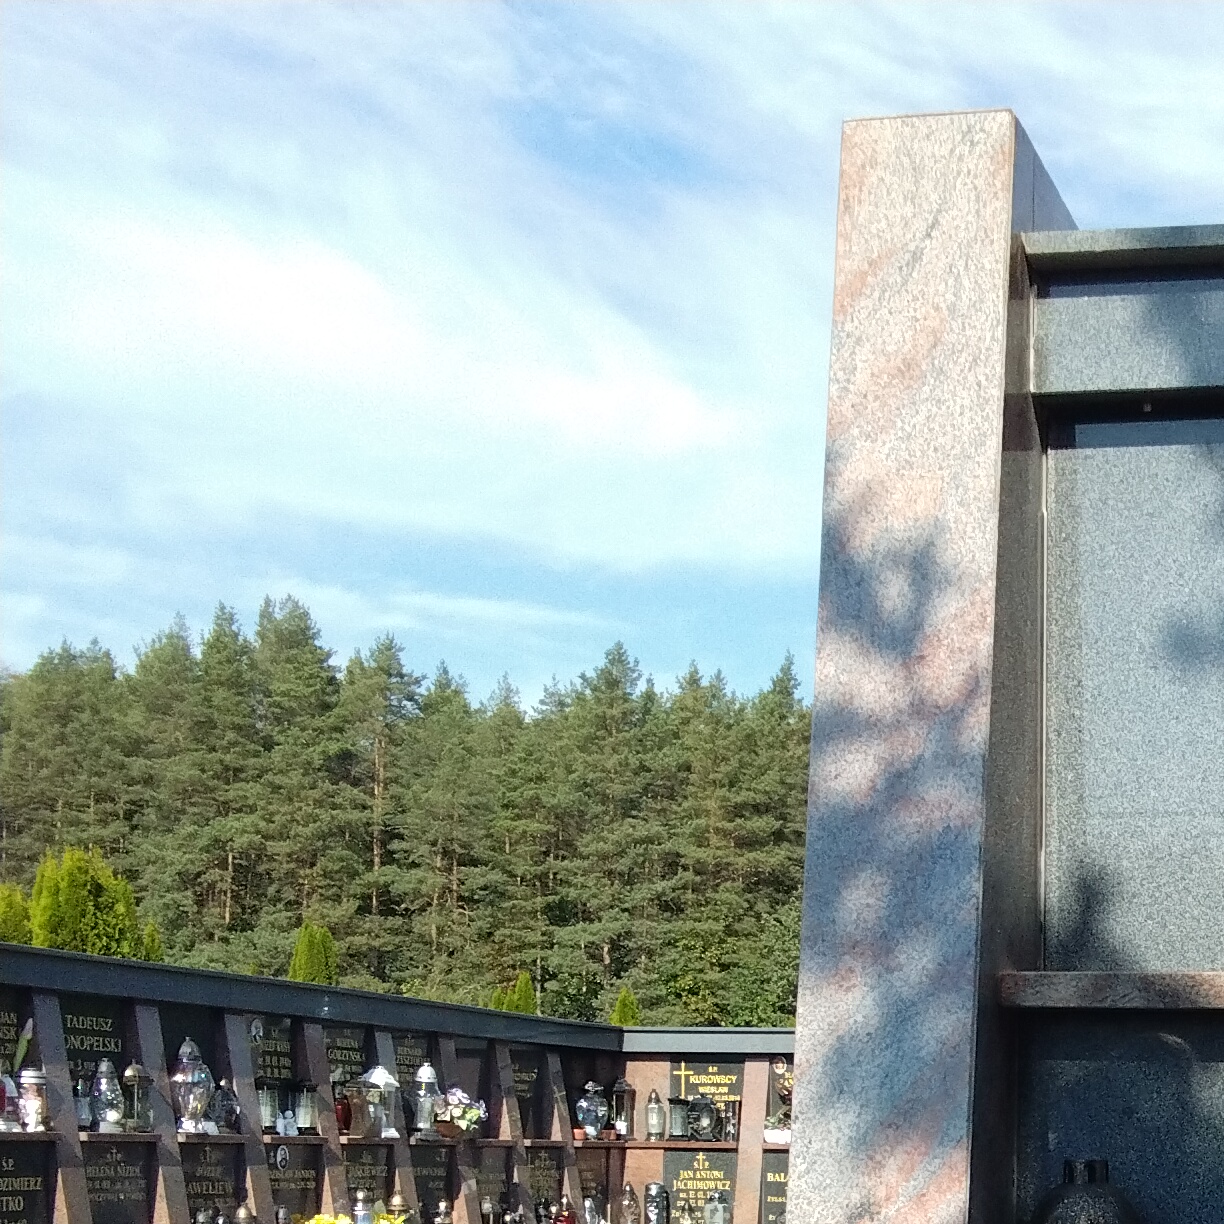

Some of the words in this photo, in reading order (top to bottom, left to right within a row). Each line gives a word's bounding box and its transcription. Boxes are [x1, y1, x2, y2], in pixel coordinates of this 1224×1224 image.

[65, 1014, 113, 1032] TADEUSZ
[64, 1034, 121, 1053] ONOPELSKI
[673, 1180, 731, 1191] JACHIMOWICZ
